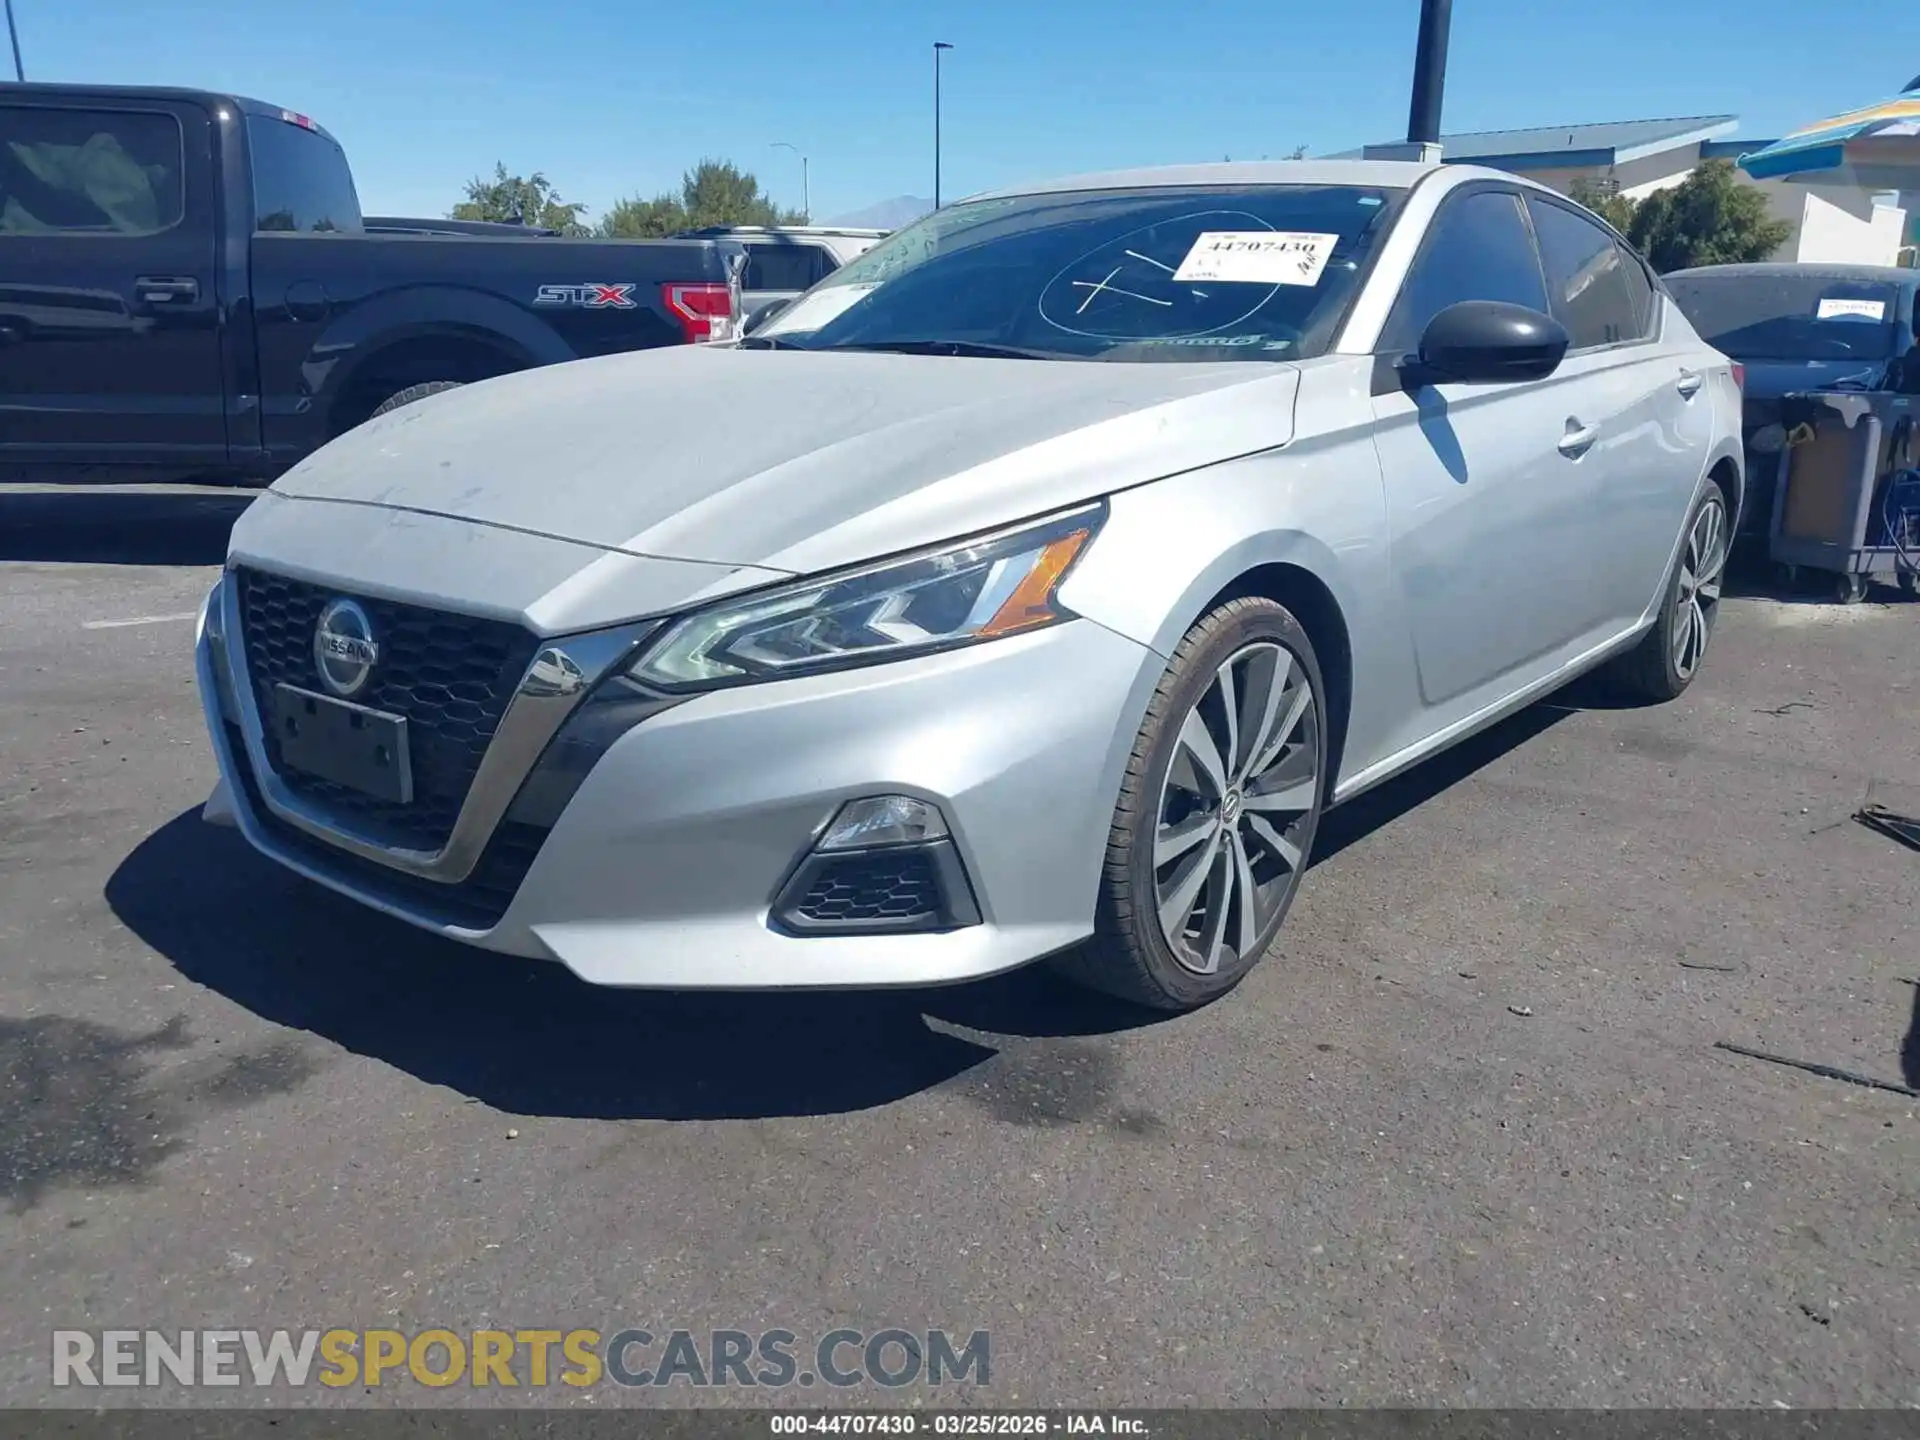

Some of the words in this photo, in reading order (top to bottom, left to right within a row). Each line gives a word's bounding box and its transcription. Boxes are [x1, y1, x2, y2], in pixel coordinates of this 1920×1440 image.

[1208, 241, 1316, 252] 44707430
[533, 283, 637, 309] STX
[320, 634, 370, 662] NISSAN
